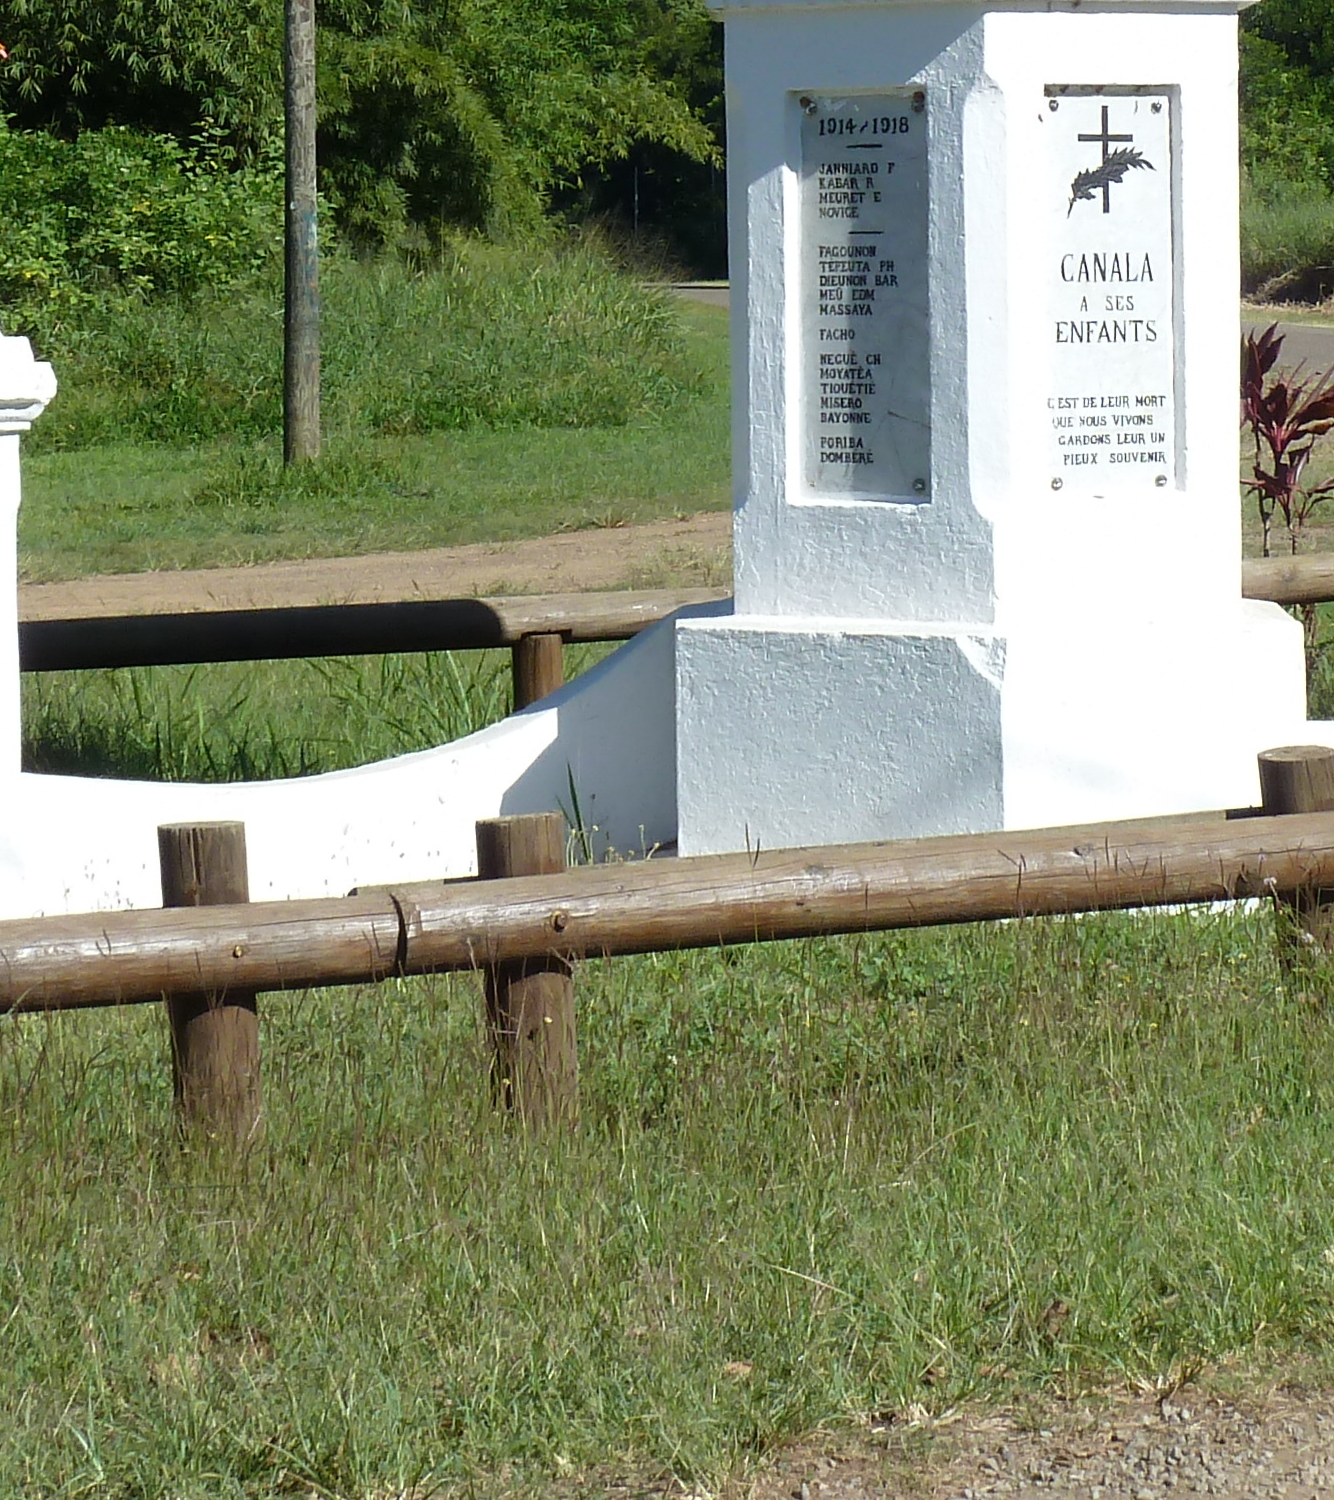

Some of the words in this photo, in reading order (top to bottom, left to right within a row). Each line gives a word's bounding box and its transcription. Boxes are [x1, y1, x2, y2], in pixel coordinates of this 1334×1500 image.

[819, 177, 859, 190] KABAR
[866, 177, 874, 189] R
[819, 192, 866, 204] MEURET
[873, 192, 882, 202] E
[880, 260, 894, 272] PH
[1061, 252, 1153, 282] CANALA
[875, 275, 898, 287] BAR
[819, 304, 872, 316] MASSAYA
[1080, 296, 1088, 312] A
[1105, 295, 1134, 311] SES
[1055, 320, 1157, 343] ENFANTS
[866, 353, 881, 365] CH
[1083, 397, 1097, 408] DE
[1101, 396, 1130, 408] LEUR
[1135, 395, 1166, 407] MORT
[820, 412, 872, 424] BAYONNE
[1052, 416, 1074, 429] QUE
[1079, 416, 1107, 427] NOUS
[1111, 414, 1153, 427] VIVONS
[1058, 434, 1111, 446] GARDONS
[1117, 433, 1146, 445] LEUR
[1151, 432, 1165, 444] UN
[1063, 453, 1098, 466] PIEUX
[1109, 451, 1167, 464] SOUVENIR
